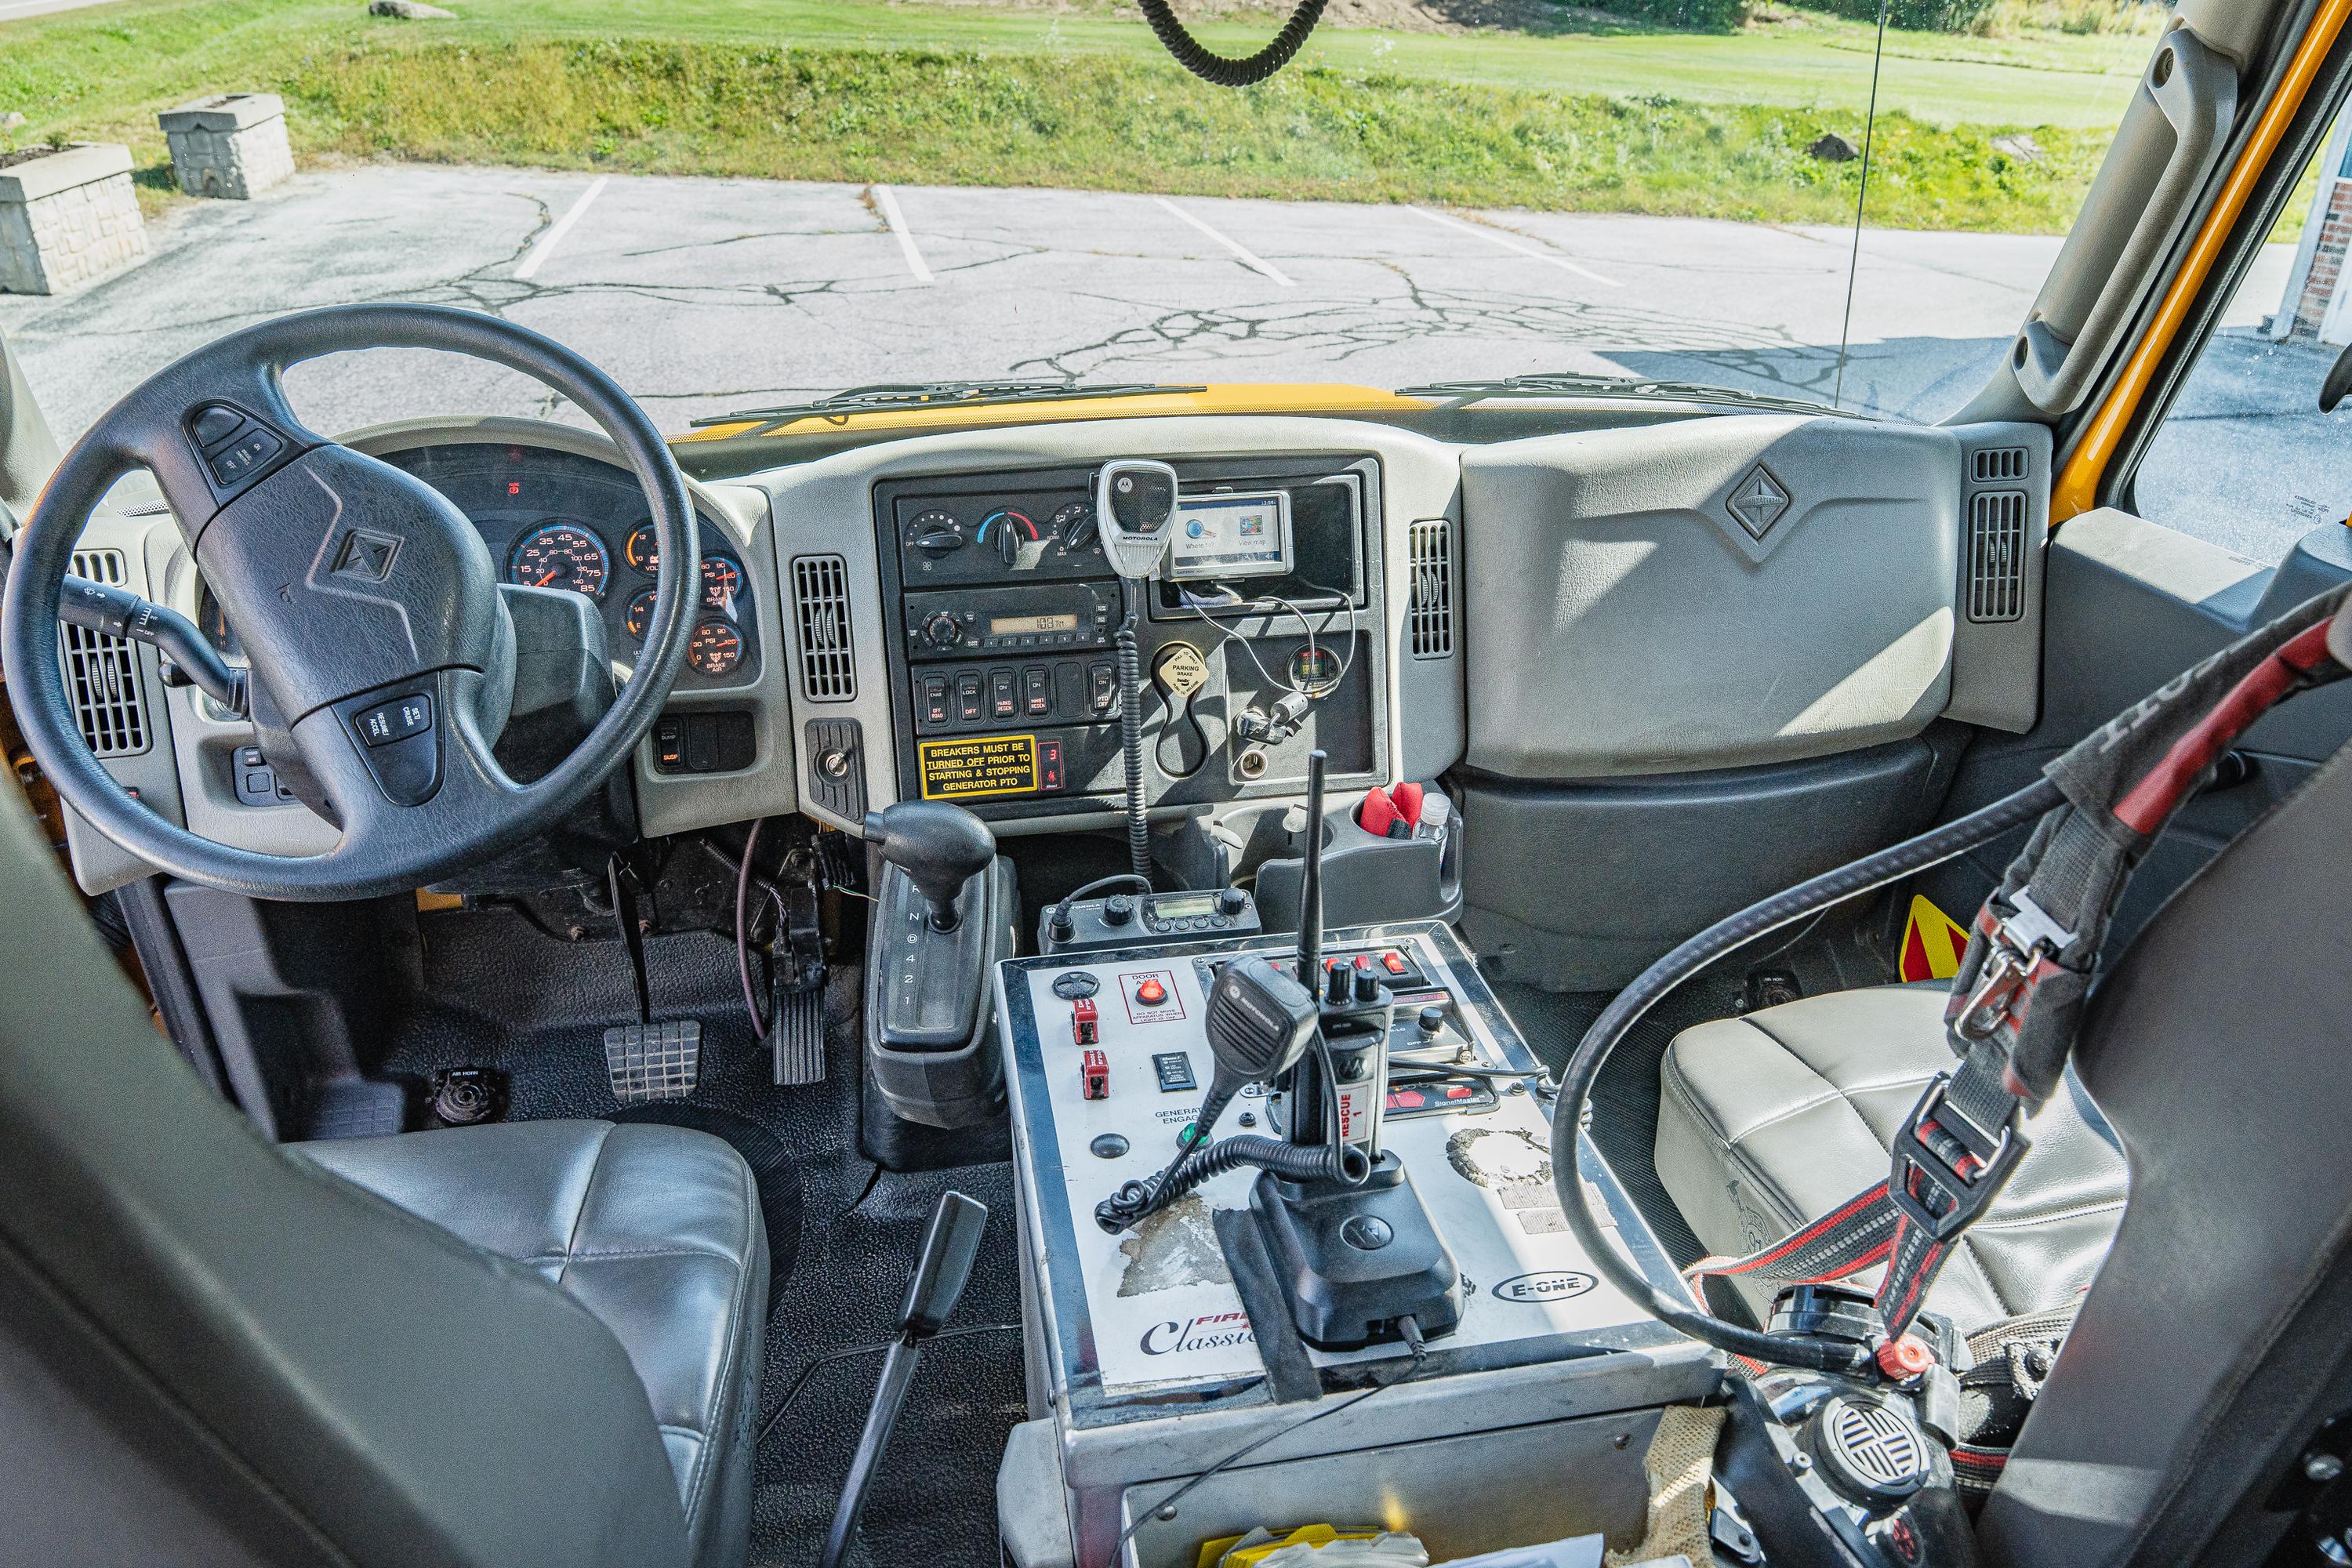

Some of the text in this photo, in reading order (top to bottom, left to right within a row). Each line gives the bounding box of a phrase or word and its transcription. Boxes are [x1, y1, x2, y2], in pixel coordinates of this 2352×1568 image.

[376, 712, 389, 735] RESUME/
[403, 707, 414, 726] CRUISE
[370, 718, 379, 737] ACCEL
[931, 742, 1024, 757] BREAKERS MUST BE
[1050, 750, 1057, 760] 3
[927, 753, 1030, 771] TURNED OFF PRIOR TO
[928, 770, 972, 781] STARTING
[986, 765, 1030, 776] STOPPING
[942, 778, 1018, 791] GENERATOR PTO
[905, 996, 909, 1005] 1
[1241, 997, 1279, 1032] MOTOROLA
[1156, 1107, 1203, 1118] GENERAT
[1163, 1115, 1200, 1124] ENGAG
[1341, 1094, 1351, 1137] RESCUE
[1512, 1277, 1581, 1297] E-ONE
